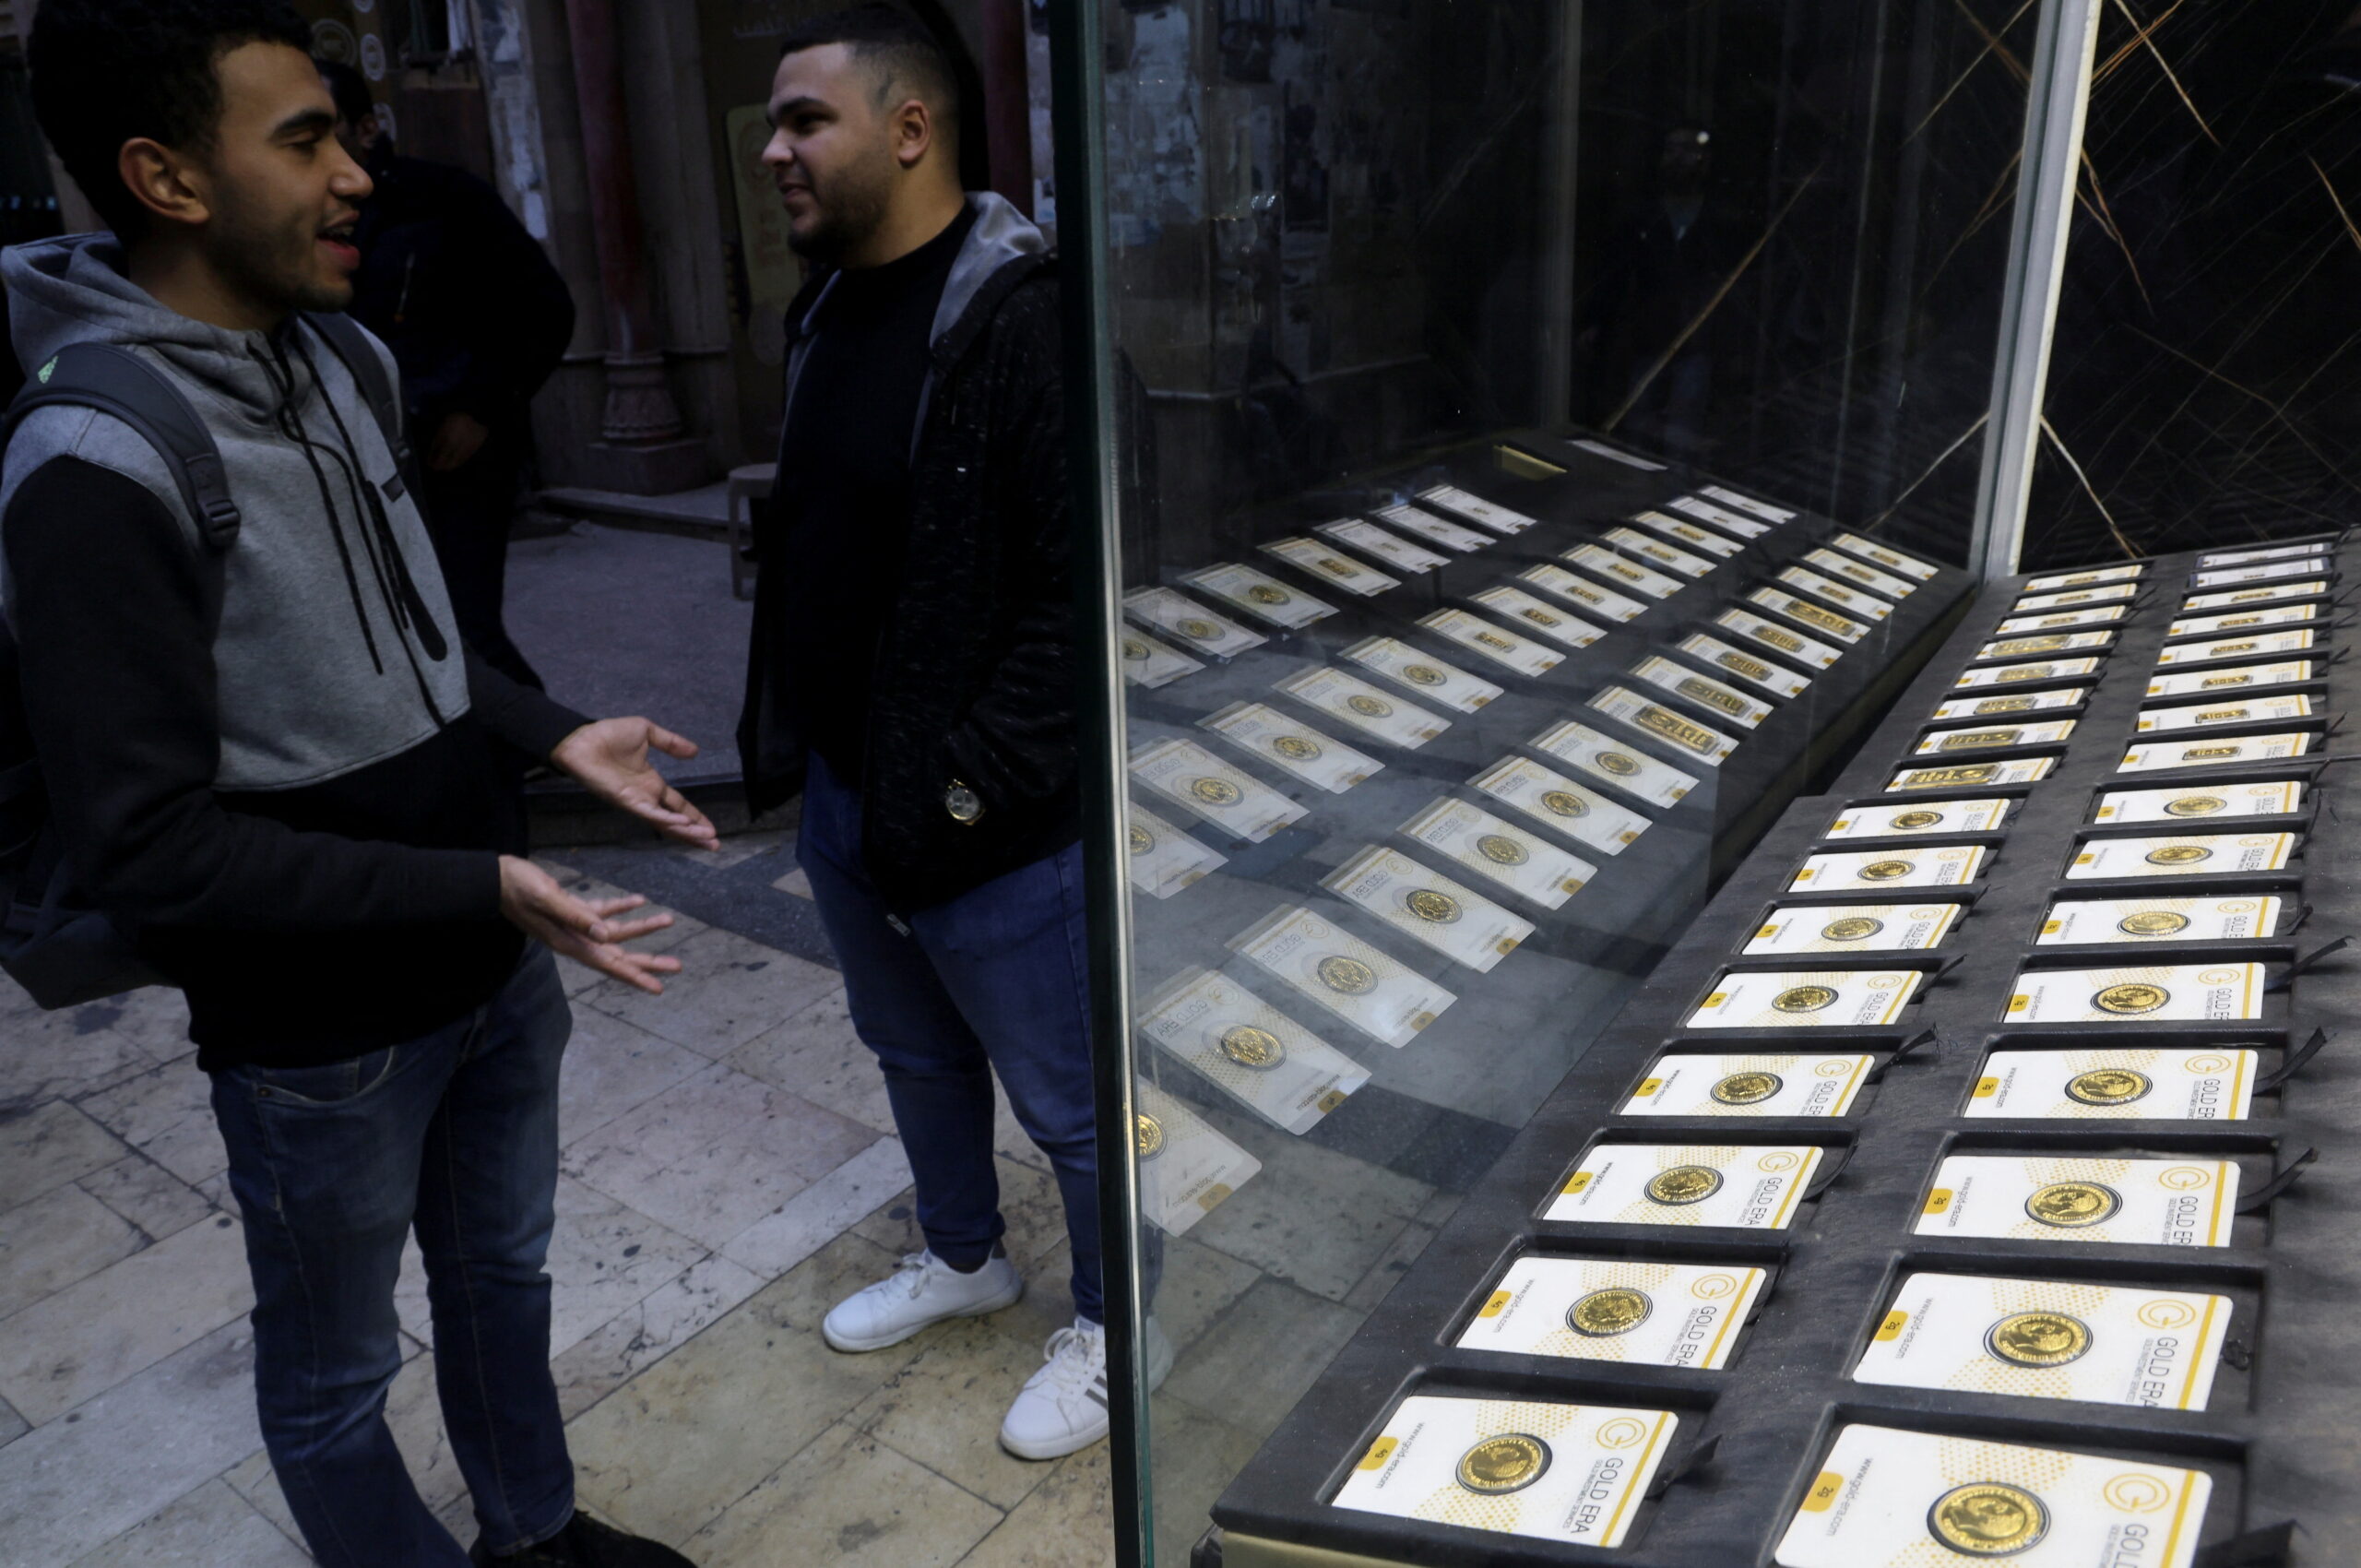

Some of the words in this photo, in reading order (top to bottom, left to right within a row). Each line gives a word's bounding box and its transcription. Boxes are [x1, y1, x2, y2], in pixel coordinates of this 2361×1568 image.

[2215, 988, 2232, 1009] GOLD
[1815, 1081, 1837, 1103] GOLD
[2201, 1079, 2221, 1105] GOLD
[2197, 1107, 2215, 1120] ER
[1758, 1177, 1782, 1205] GOLD
[1744, 1207, 1767, 1226] ERA
[2177, 1195, 2199, 1227] GOLD
[2174, 1230, 2192, 1245] ER
[1493, 1278, 1535, 1333] www.gold-era.com
[1688, 1306, 1717, 1340] GOLD
[1885, 1321, 1900, 1330] 2g
[1895, 1297, 1933, 1359] www.gold-era.com
[2149, 1337, 2178, 1376] GOLD
[1374, 1448, 1388, 1459] 4g
[1376, 1421, 1425, 1489] www.gold-era.com
[1590, 1457, 1623, 1501] GOLD
[1817, 1487, 1833, 1498] 2g
[1828, 1458, 1872, 1537] www.gold-era.com
[1571, 1505, 1601, 1534] ERA
